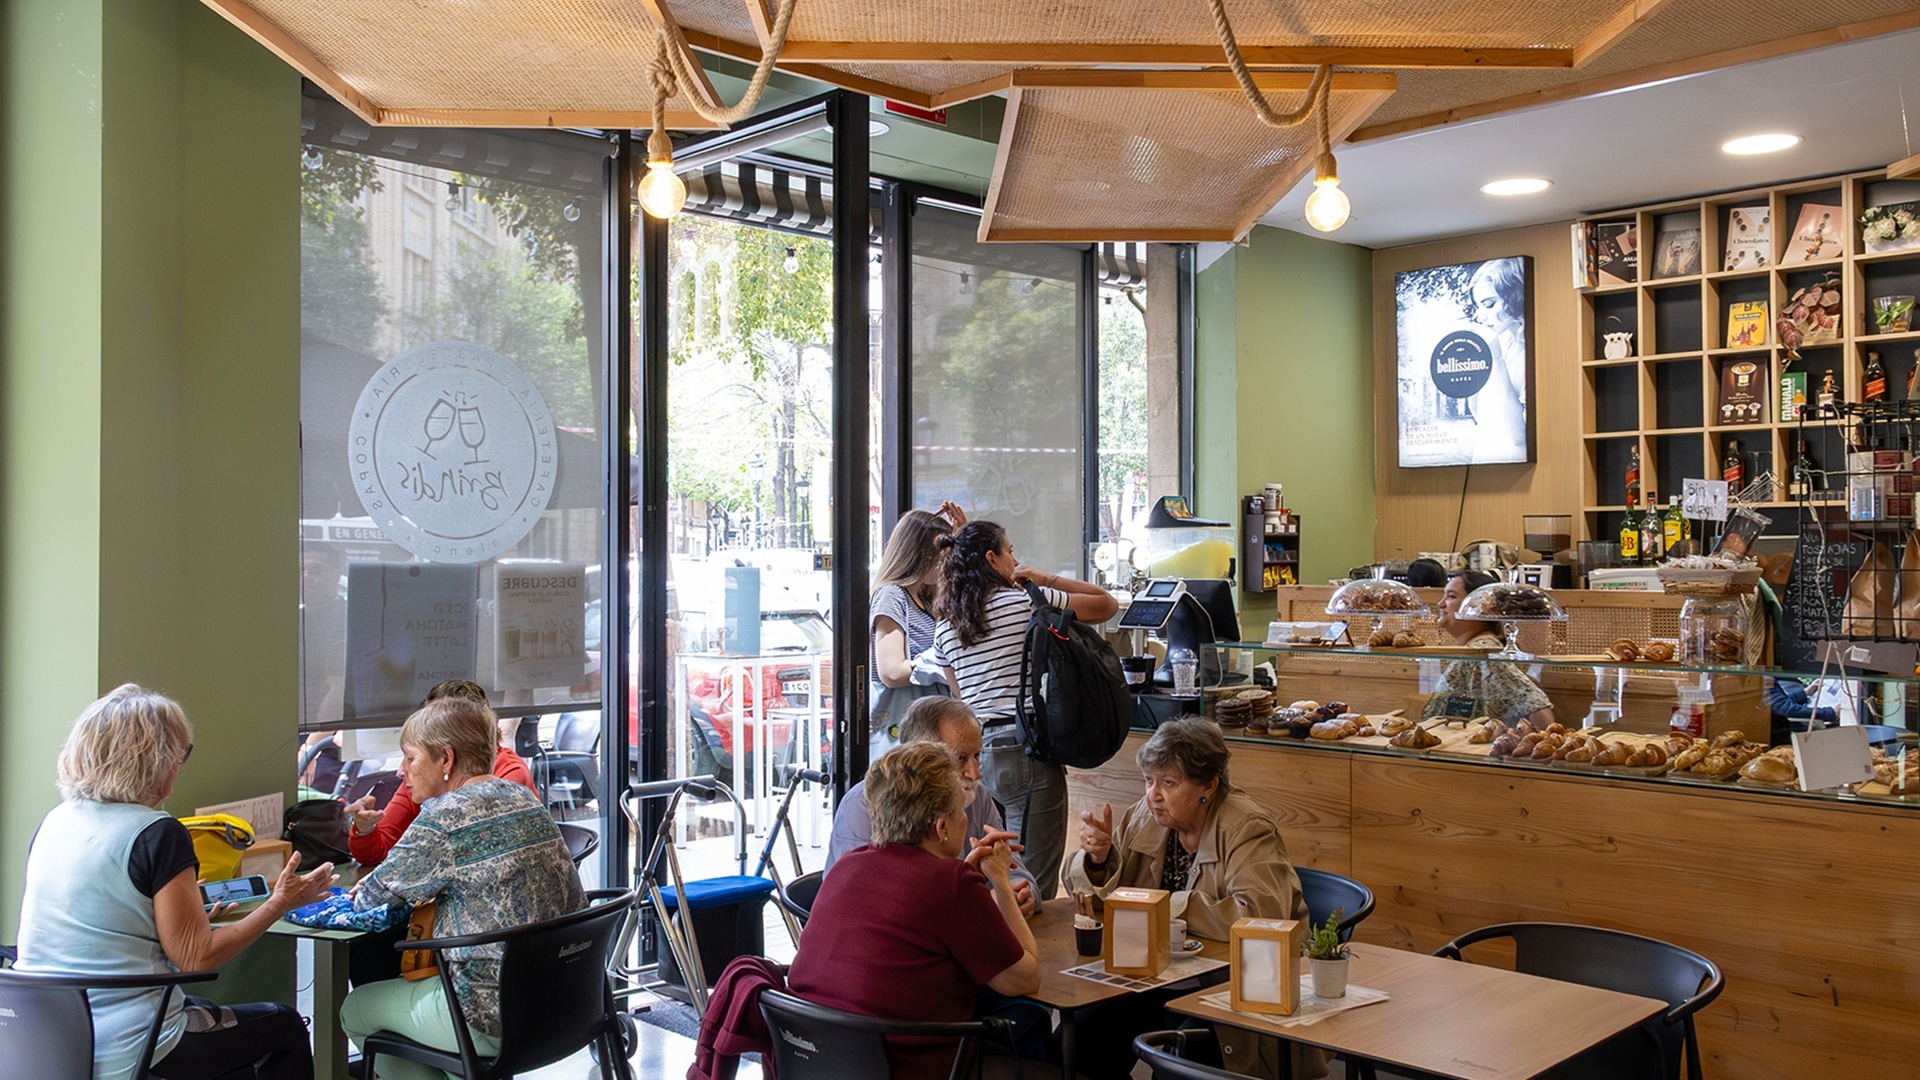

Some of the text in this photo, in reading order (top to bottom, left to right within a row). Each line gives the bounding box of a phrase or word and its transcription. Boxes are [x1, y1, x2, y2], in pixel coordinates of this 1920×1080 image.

[1436, 357, 1489, 374] bellissimo.
[335, 528, 388, 540] EN GENE
